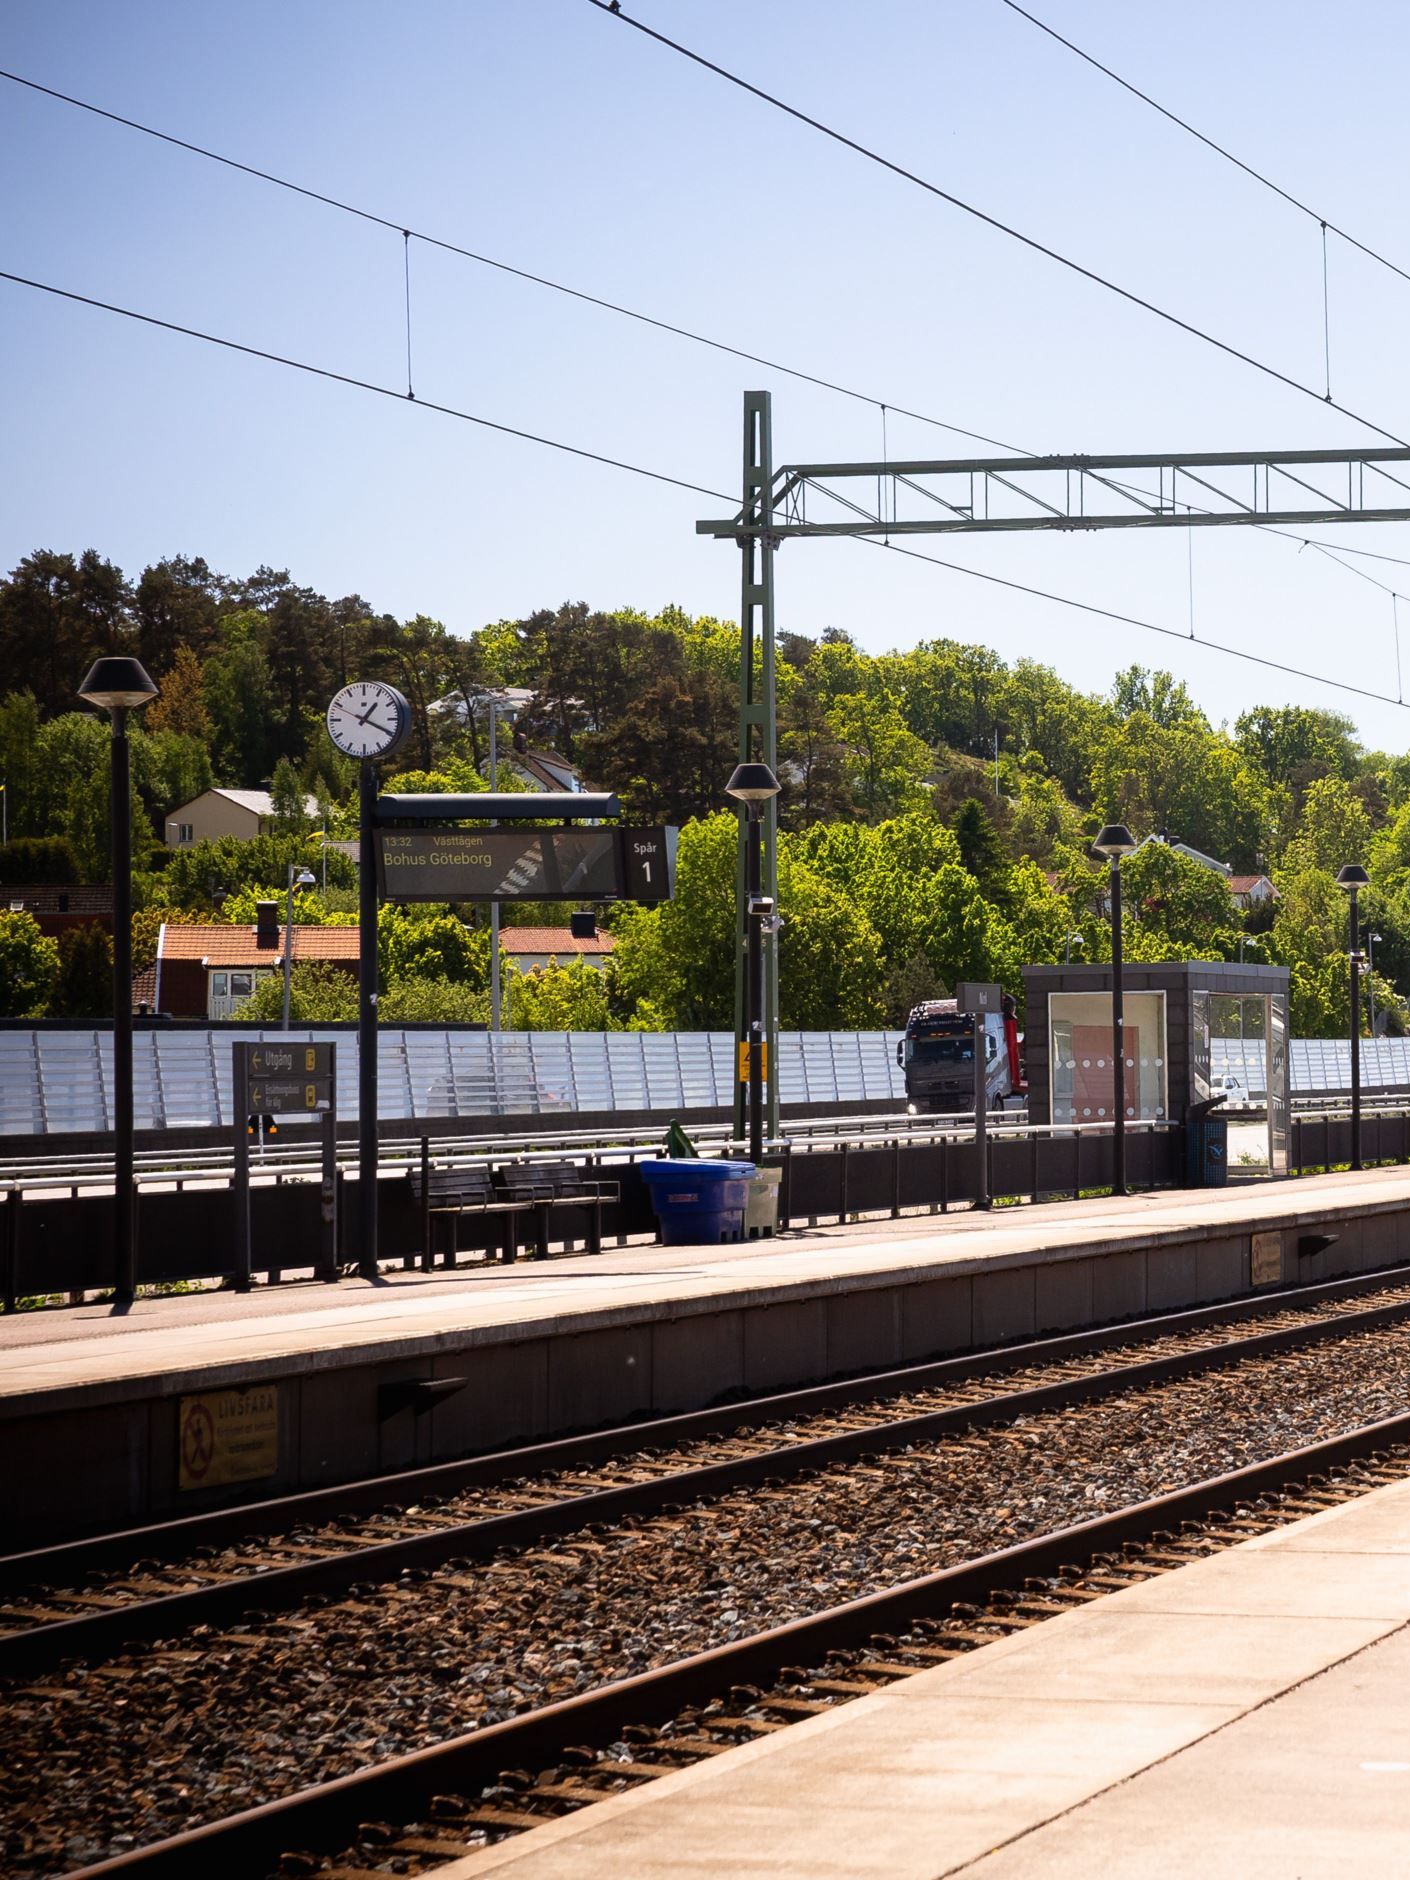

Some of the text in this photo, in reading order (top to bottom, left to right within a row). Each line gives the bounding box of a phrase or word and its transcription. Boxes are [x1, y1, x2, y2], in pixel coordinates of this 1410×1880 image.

[384, 835, 483, 848] 13:32 Västtågen
[633, 842, 657, 855] Spår
[384, 852, 492, 868] Bohus Göteborg
[642, 861, 652, 883] 1
[265, 1049, 293, 1070] Utgång
